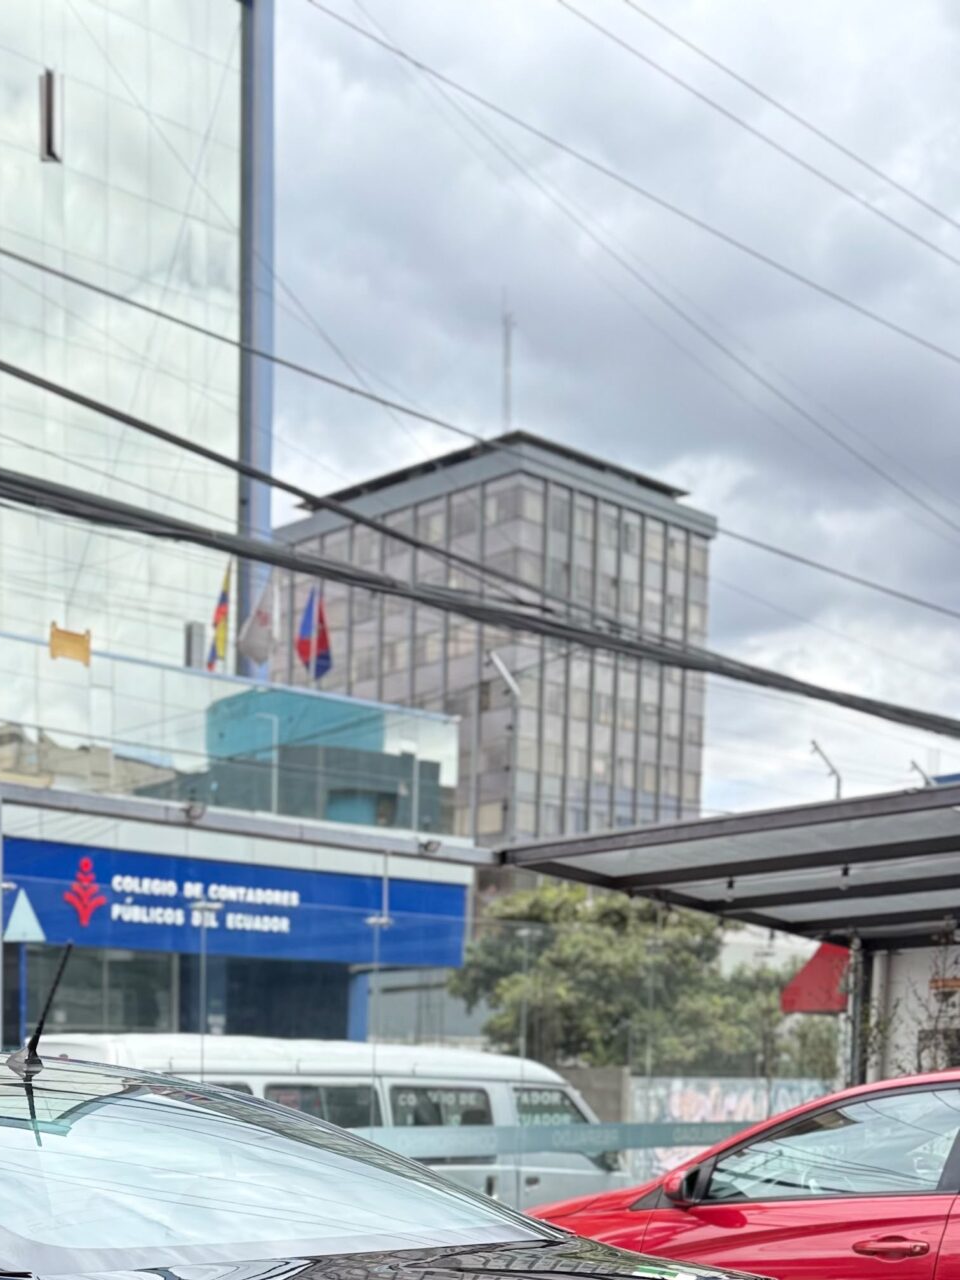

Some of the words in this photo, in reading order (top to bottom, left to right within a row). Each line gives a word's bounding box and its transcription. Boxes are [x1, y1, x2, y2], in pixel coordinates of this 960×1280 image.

[111, 874, 178, 897] COLEGIO
[183, 881, 204, 898] DE
[208, 884, 300, 907] CONTADORES
[111, 896, 185, 926] PÚBLICOS
[225, 912, 290, 933] ECUADOR
